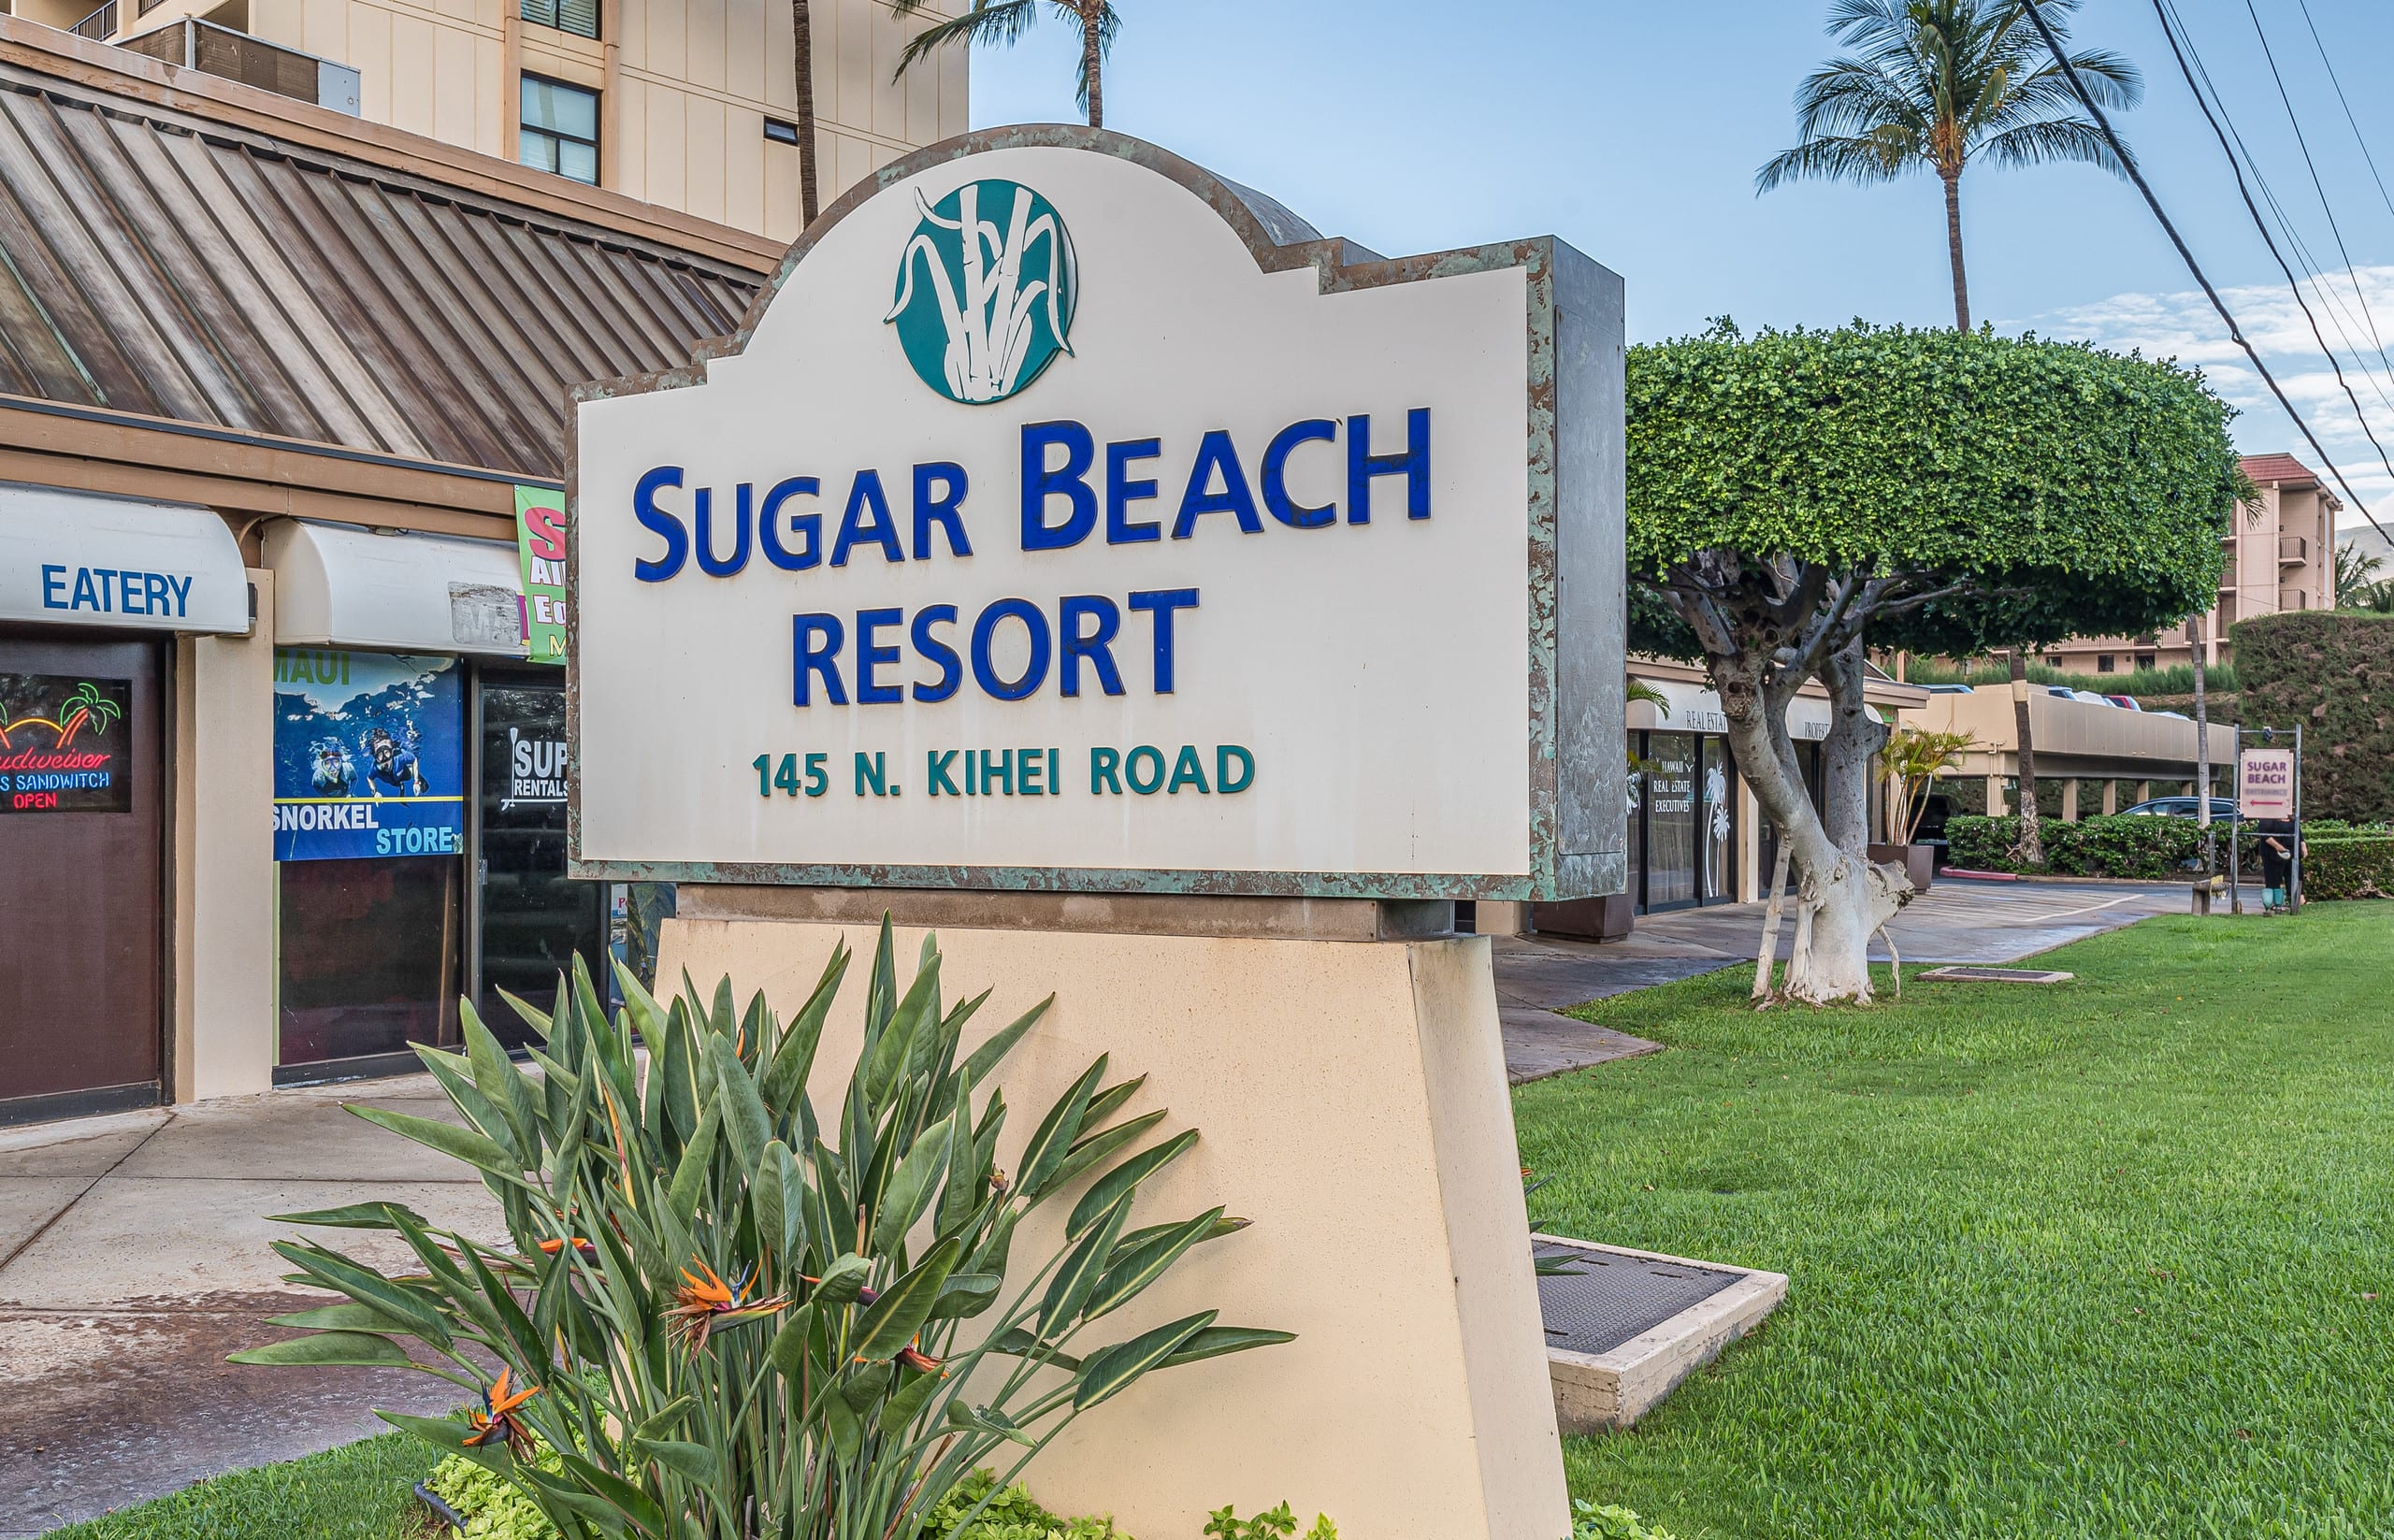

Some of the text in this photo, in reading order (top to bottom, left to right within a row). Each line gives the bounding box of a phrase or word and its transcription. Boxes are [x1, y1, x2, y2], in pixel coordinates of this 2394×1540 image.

[632, 407, 1432, 583] SUGAR BEACH
[41, 564, 193, 618] EATERY
[792, 588, 1200, 707] RESORT
[1686, 711, 1726, 731] REAL ESTAT
[0, 746, 111, 770] udweiser
[514, 740, 568, 778] SUP
[1662, 760, 1683, 773] HAWAII
[2247, 761, 2286, 771] SUGAR
[16, 772, 109, 790] SANDWITCH
[753, 745, 1256, 798] 145 N. KIHEI ROAD
[2247, 774, 2286, 784] BEACH
[513, 779, 568, 797] RENTALS
[1653, 780, 1690, 793] REAL ESTATE
[13, 792, 58, 809] OPEN
[1655, 799, 1690, 813] EXECUTIVES
[273, 804, 379, 831] SNORKEL
[376, 826, 453, 855] STORE
